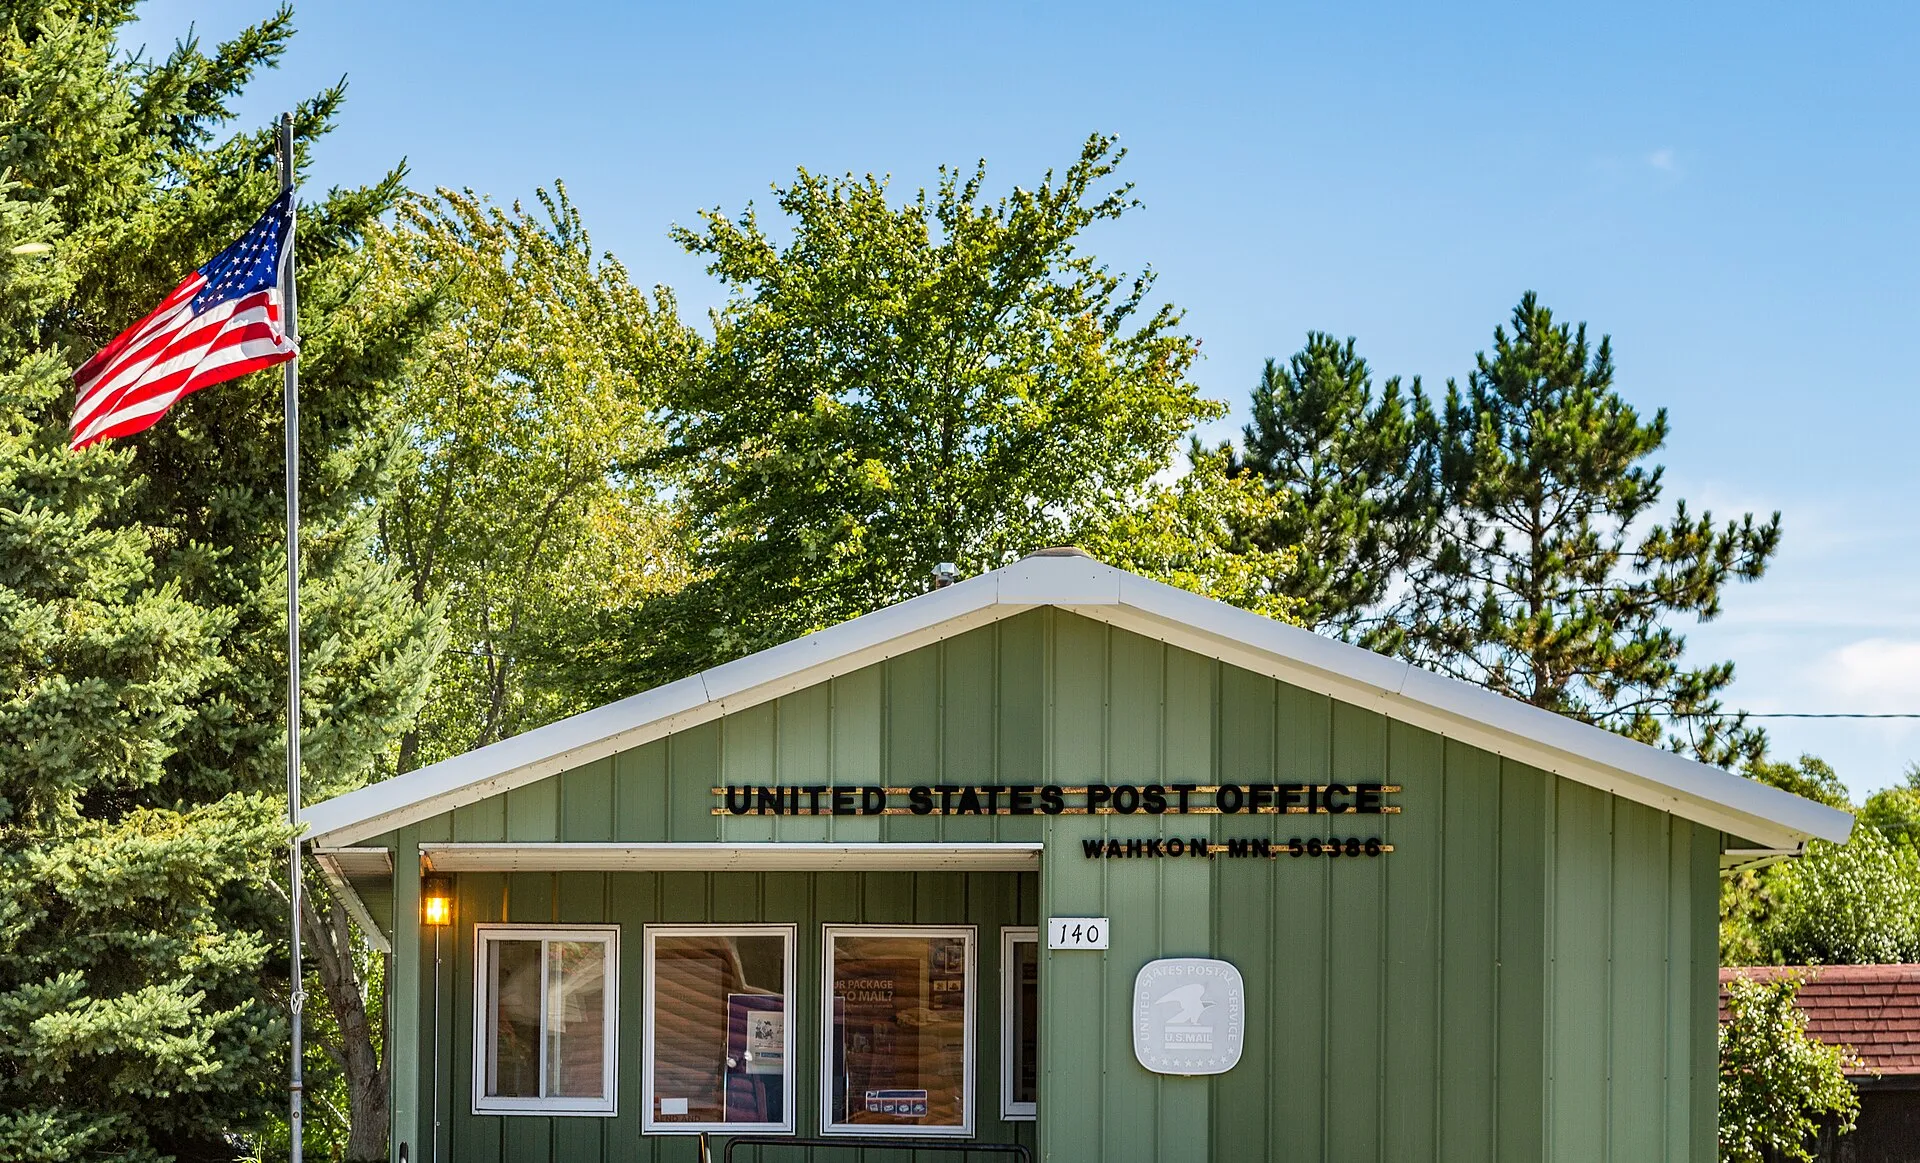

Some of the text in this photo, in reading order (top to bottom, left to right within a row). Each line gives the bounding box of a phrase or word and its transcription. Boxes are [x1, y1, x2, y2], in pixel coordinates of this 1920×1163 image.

[727, 783, 1382, 815] UNITED STATES POST OFFICE
[1288, 838, 1382, 858] 56386
[1060, 924, 1099, 944] 140
[848, 979, 893, 989] PACKAGE
[858, 990, 894, 1002] MAIL?
[1140, 965, 1238, 1041] UNITED STATES POSTAL SERVICE
